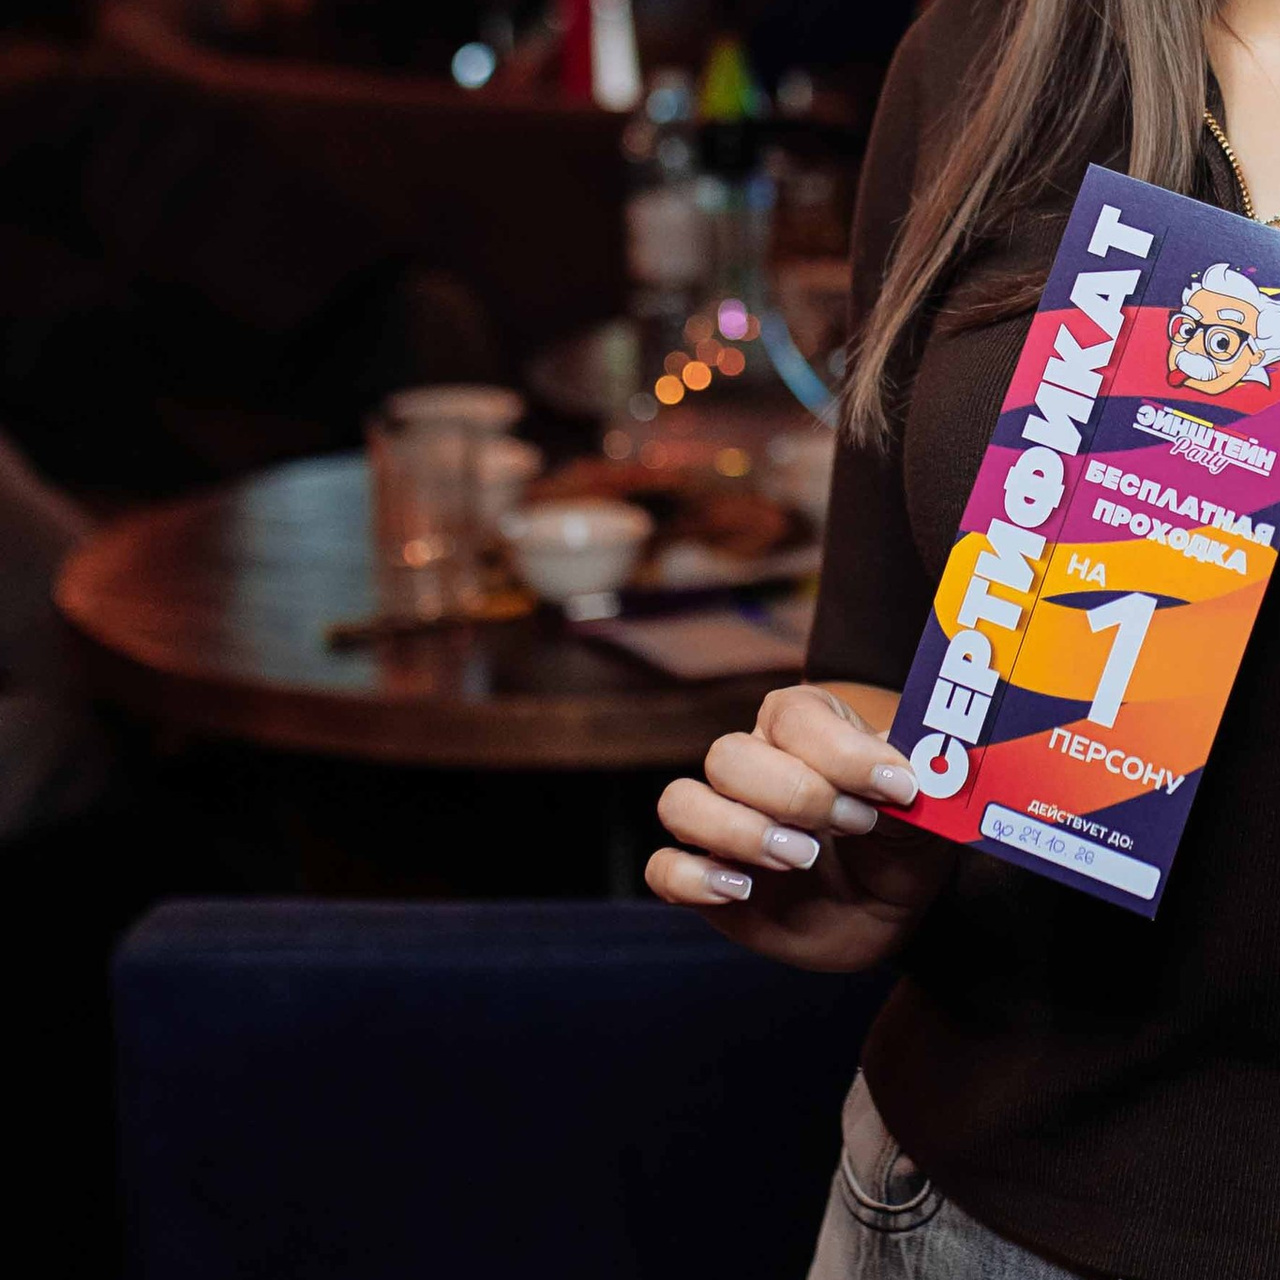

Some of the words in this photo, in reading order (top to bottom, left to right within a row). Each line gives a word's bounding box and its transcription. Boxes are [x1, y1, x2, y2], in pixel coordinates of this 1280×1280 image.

[1136, 405, 1277, 471] ЭЙНШТЕЙН
[1169, 435, 1231, 475] Party
[909, 204, 1155, 800] СЕРТИФИКАТ
[1085, 459, 1276, 547] БЕСПЛАТНАЯ
[1067, 553, 1107, 588] НА
[1092, 498, 1248, 575] ПРОХОДКА
[1086, 592, 1158, 729] 1
[1048, 727, 1185, 795] ПЕРСОНУ
[1027, 799, 1108, 839] ДЕЙСТВУЕТ
[1107, 831, 1134, 850] ДО:
